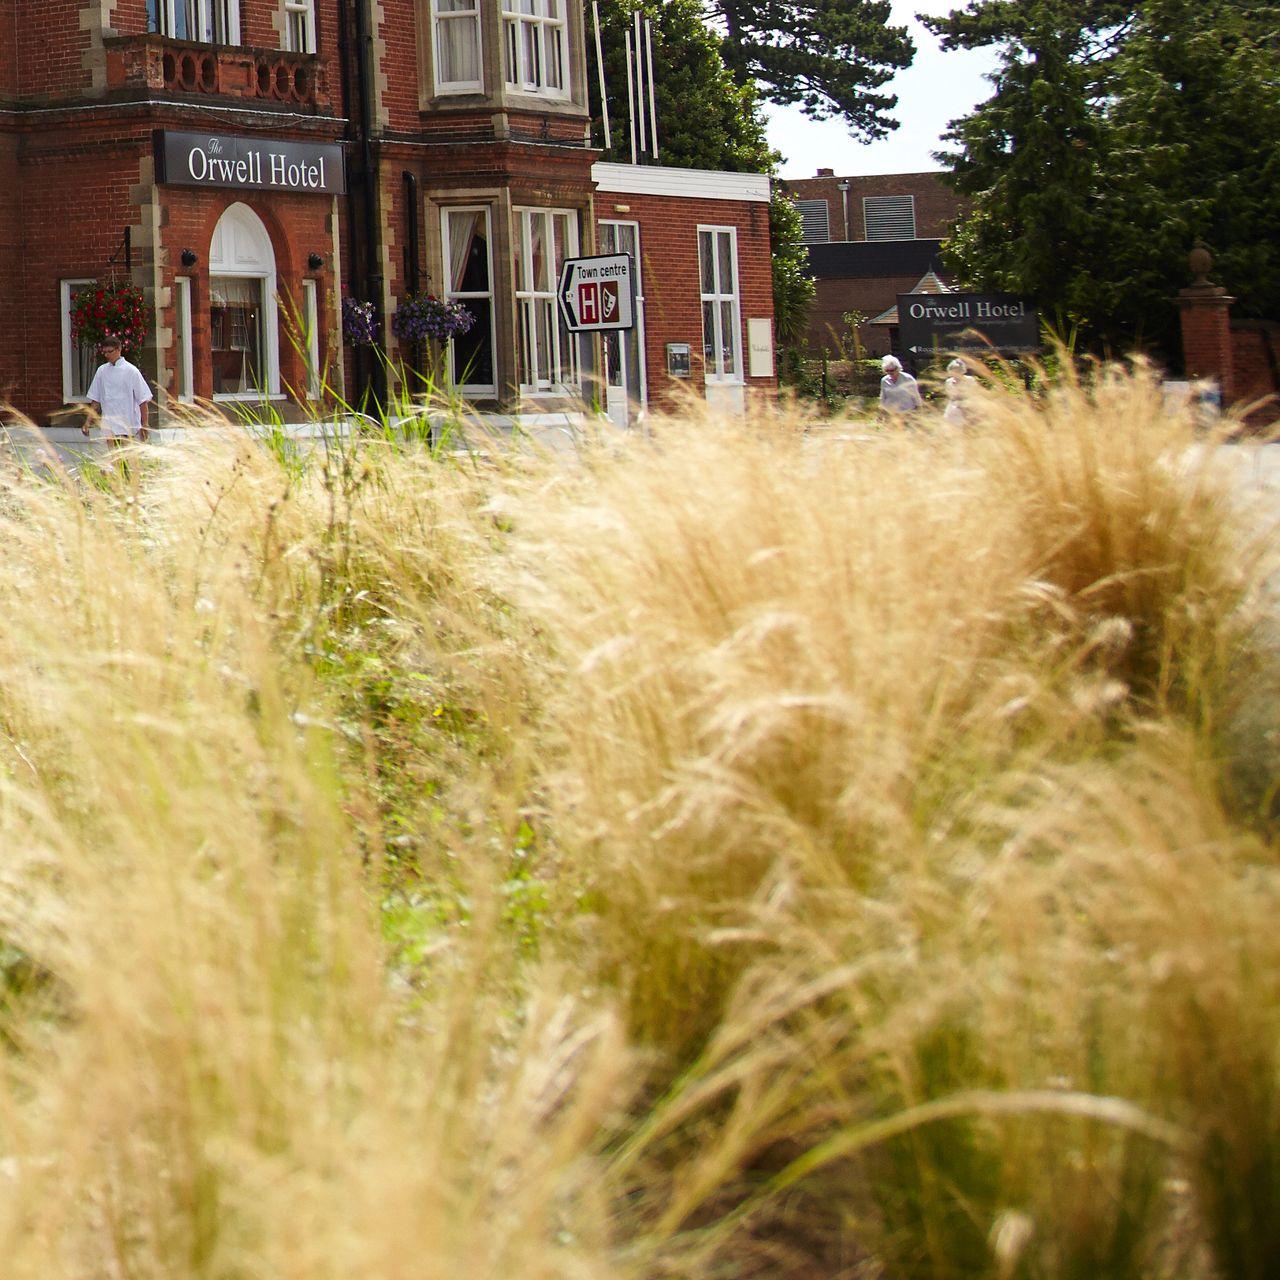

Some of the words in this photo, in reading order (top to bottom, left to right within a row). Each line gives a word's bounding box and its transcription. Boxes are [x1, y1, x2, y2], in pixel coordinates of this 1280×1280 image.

[207, 138, 224, 155] The
[188, 147, 263, 184] Orwell
[268, 153, 327, 188] Hotel
[577, 267, 598, 279] Town
[600, 263, 627, 277] centre
[909, 302, 970, 319] Orwell
[976, 301, 1025, 317] Hotel
